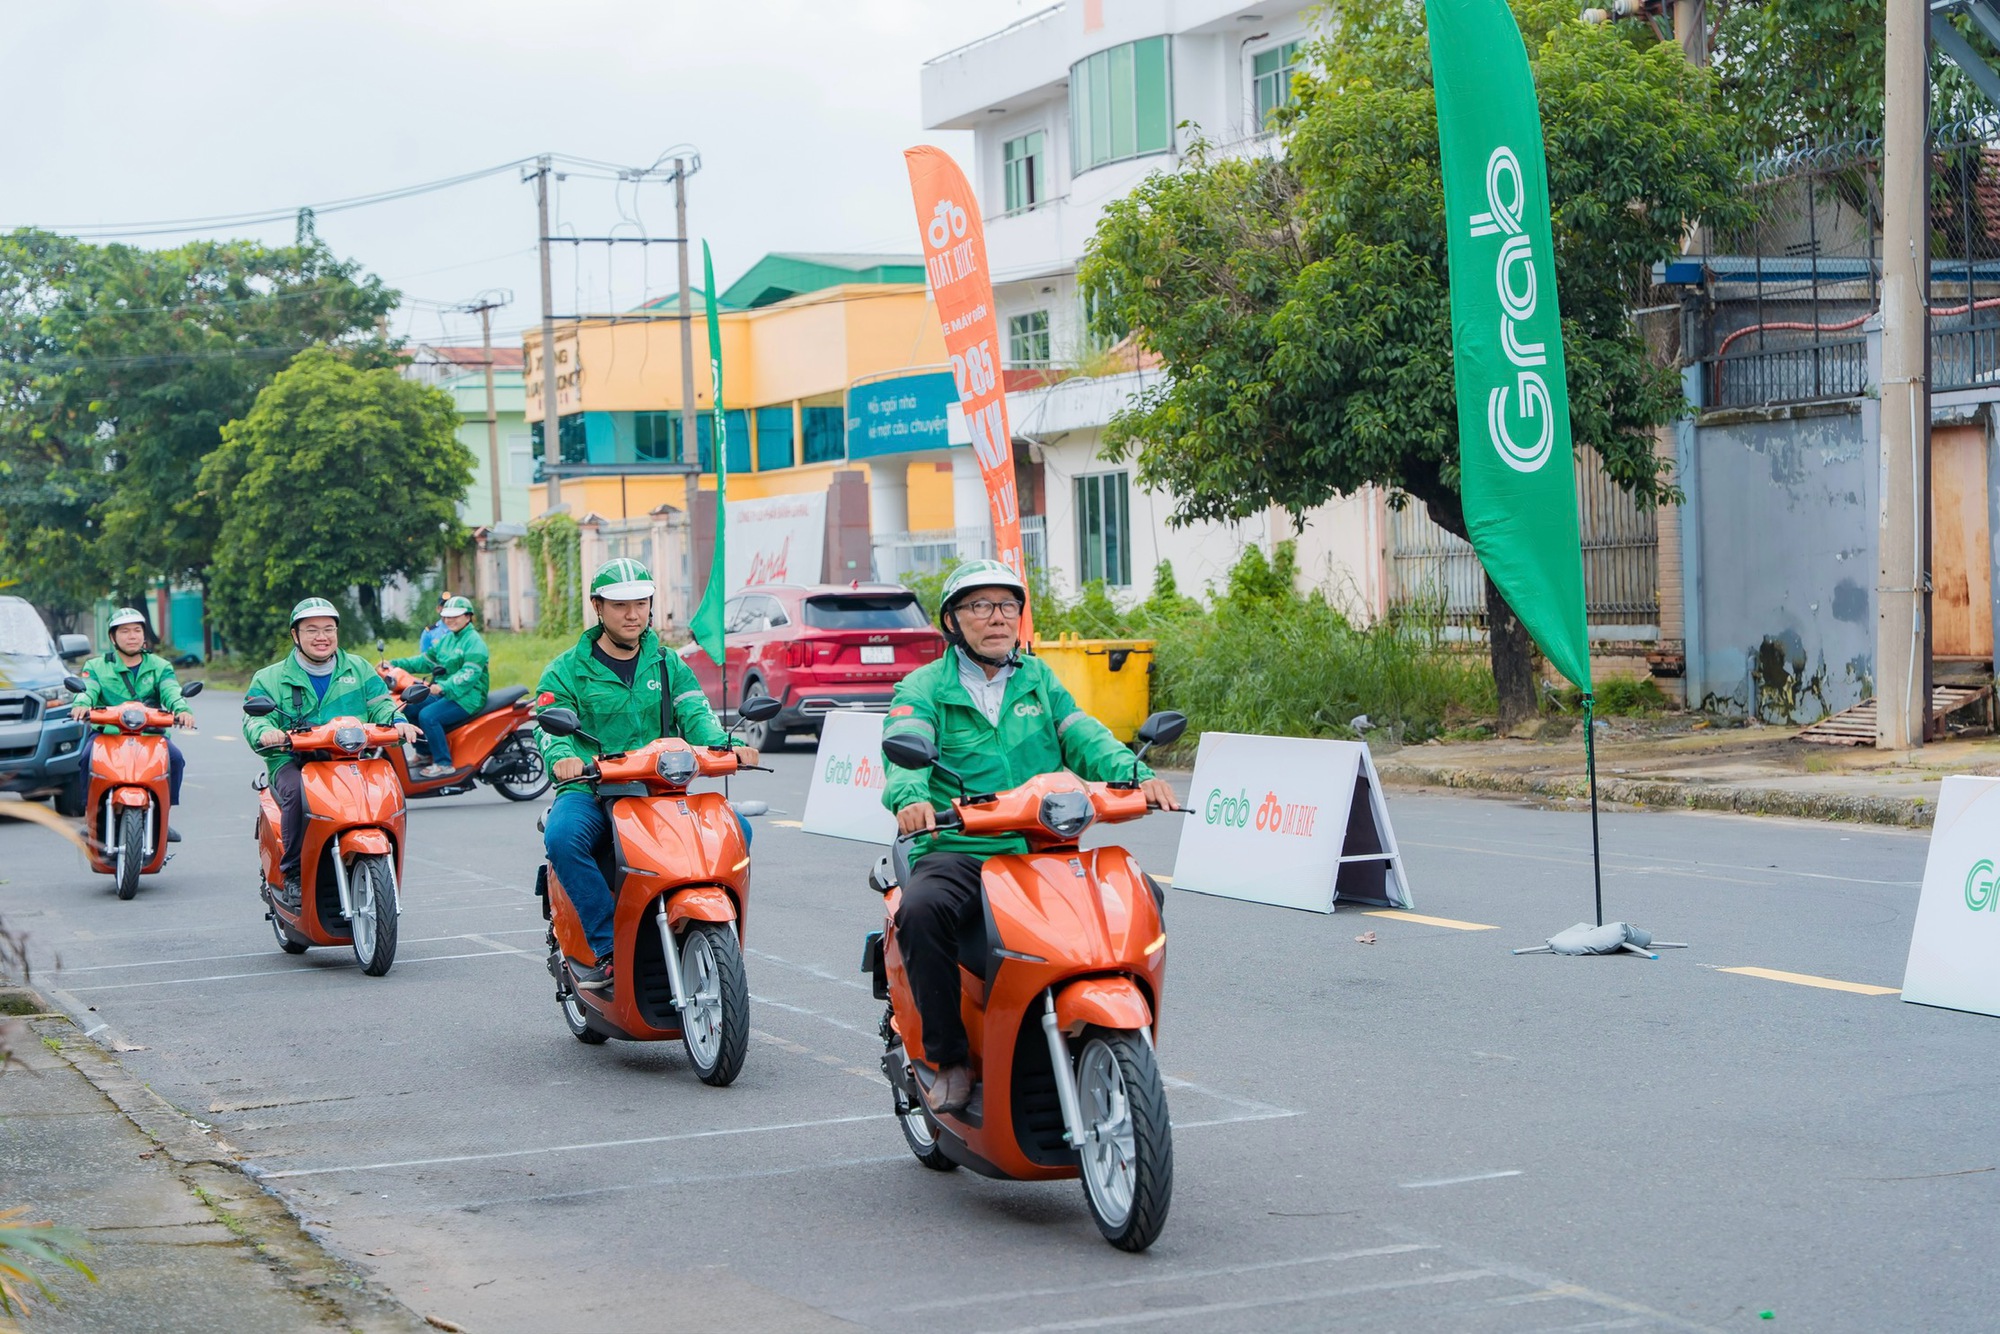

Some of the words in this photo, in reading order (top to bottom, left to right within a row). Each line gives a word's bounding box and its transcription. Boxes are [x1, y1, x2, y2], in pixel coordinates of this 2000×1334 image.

[929, 238, 977, 290] DAT.BIKE
[1469, 146, 1554, 473] Grab
[950, 339, 996, 402] 285
[825, 754, 852, 786] Grab
[1205, 788, 1250, 829] Grab
[1281, 803, 1318, 837] DAT.BIKE
